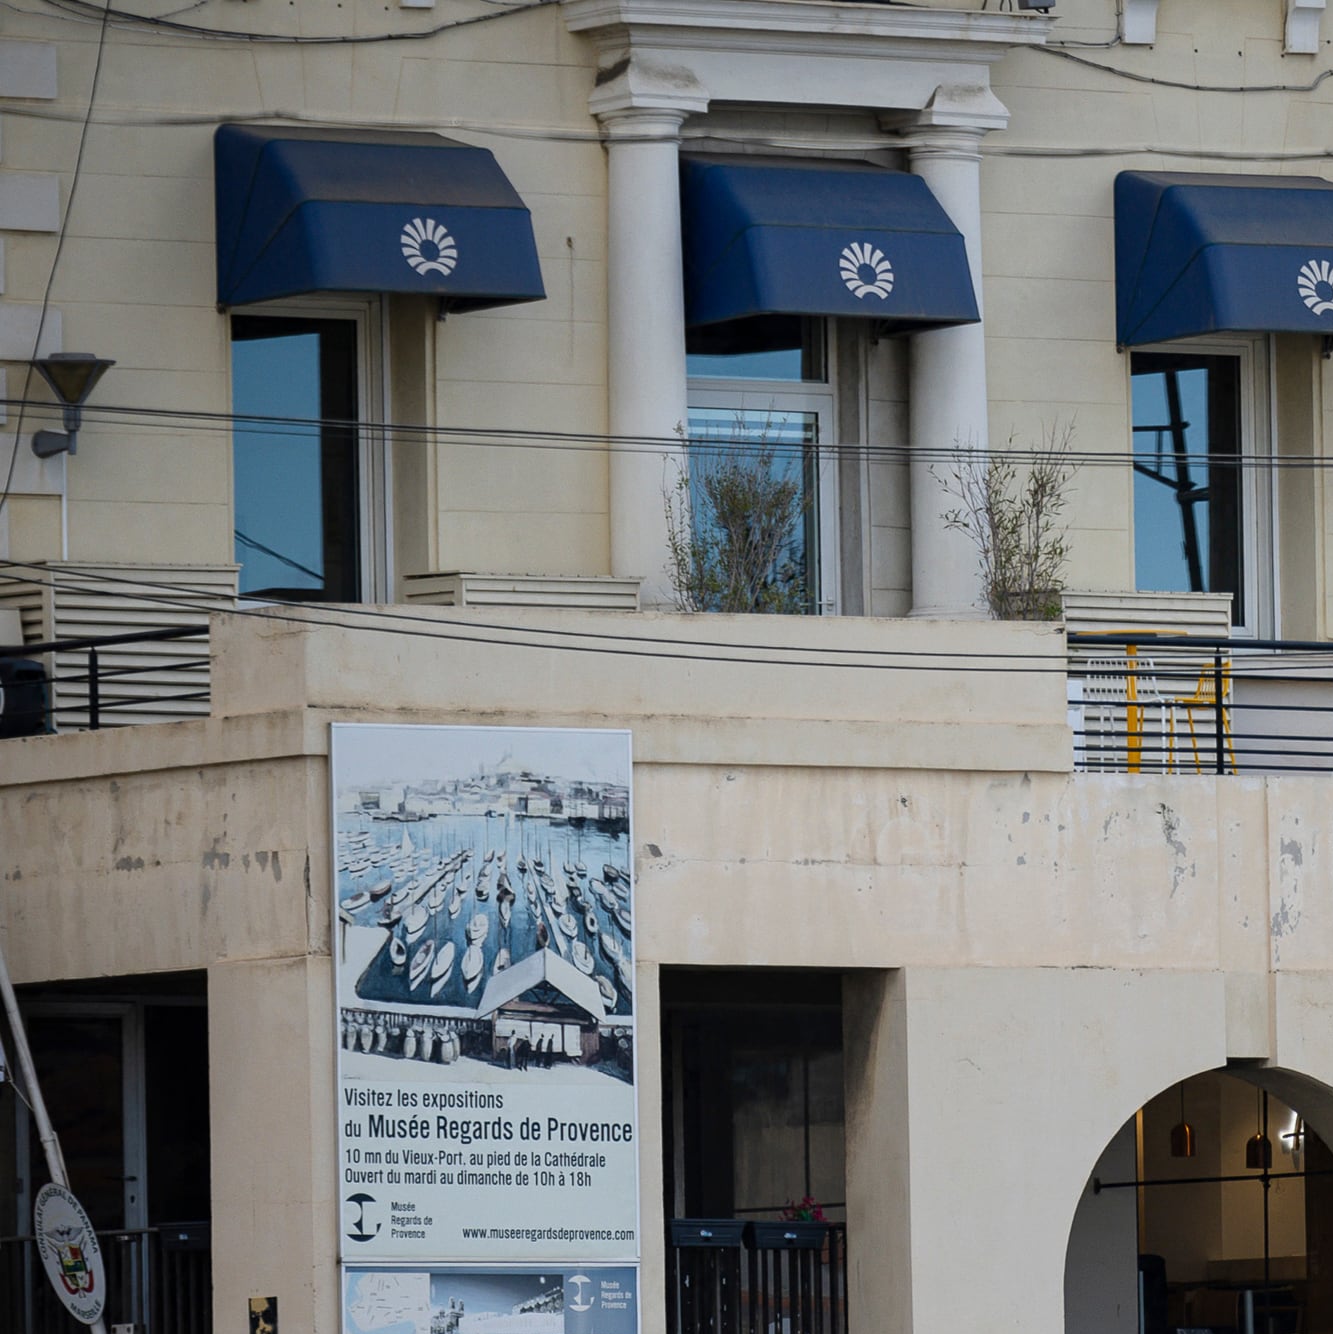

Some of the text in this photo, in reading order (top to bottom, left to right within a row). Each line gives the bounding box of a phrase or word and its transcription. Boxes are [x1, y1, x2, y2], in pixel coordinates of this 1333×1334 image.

[344, 1088, 504, 1111] Visitez les expositions
[344, 1114, 633, 1145] du Musée Regards de Provence
[345, 1150, 360, 1165] 10
[364, 1152, 382, 1165] mn
[385, 1150, 399, 1165] du
[470, 1155, 484, 1166] au
[487, 1152, 511, 1170] pied
[514, 1152, 528, 1167] de
[531, 1152, 542, 1167] la
[544, 1152, 606, 1168] Cathédrale
[345, 1168, 592, 1187] Ouvert du mardi au dimanche de 10h à 18h
[391, 1201, 416, 1212] Musée
[391, 1215, 433, 1227] Regards de
[76, 1210, 98, 1254] PANAMA
[391, 1229, 425, 1239] Provence
[462, 1227, 635, 1242] www.museeregardsdeprovence.com
